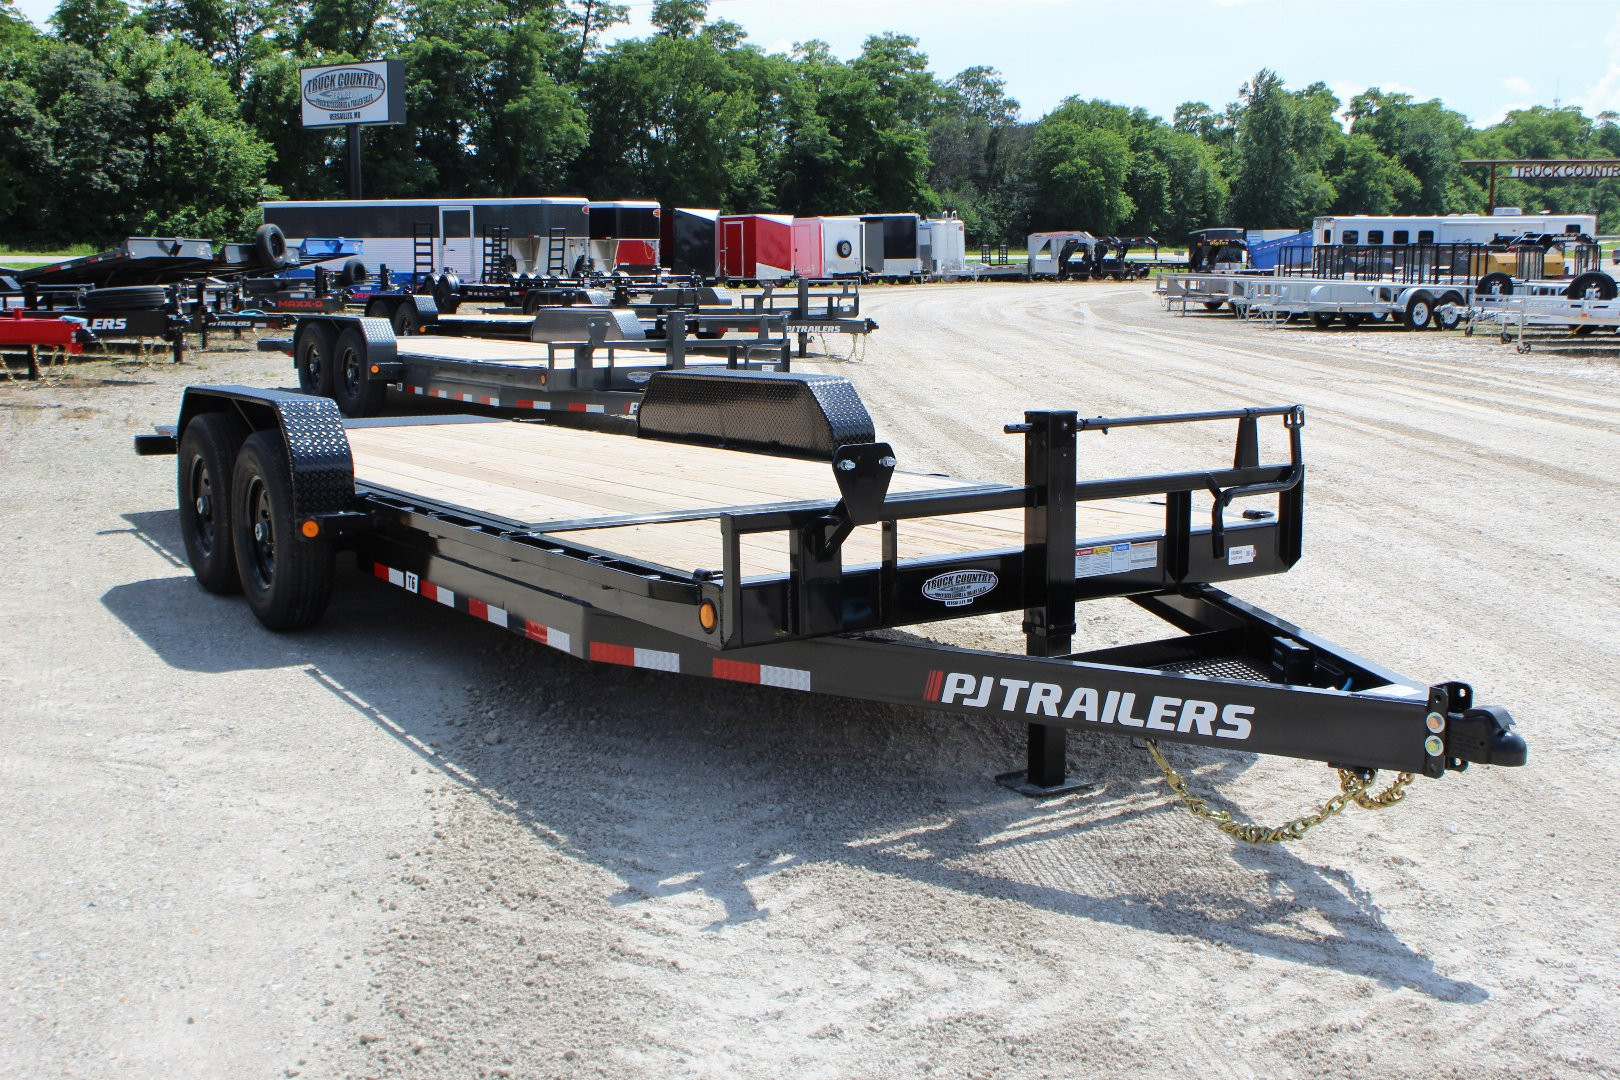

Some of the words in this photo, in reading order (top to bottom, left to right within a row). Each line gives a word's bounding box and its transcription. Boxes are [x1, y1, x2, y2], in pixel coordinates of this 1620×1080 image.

[307, 74, 336, 94] TRUCK
[338, 72, 380, 88] COUNTRY
[1515, 165, 1562, 178] TRUCK
[794, 325, 841, 333] TRAILERS
[926, 575, 956, 590] TRUCK
[956, 573, 994, 584] COUNTRY
[941, 672, 993, 709] PJ
[999, 678, 1257, 740] TRAILERS
